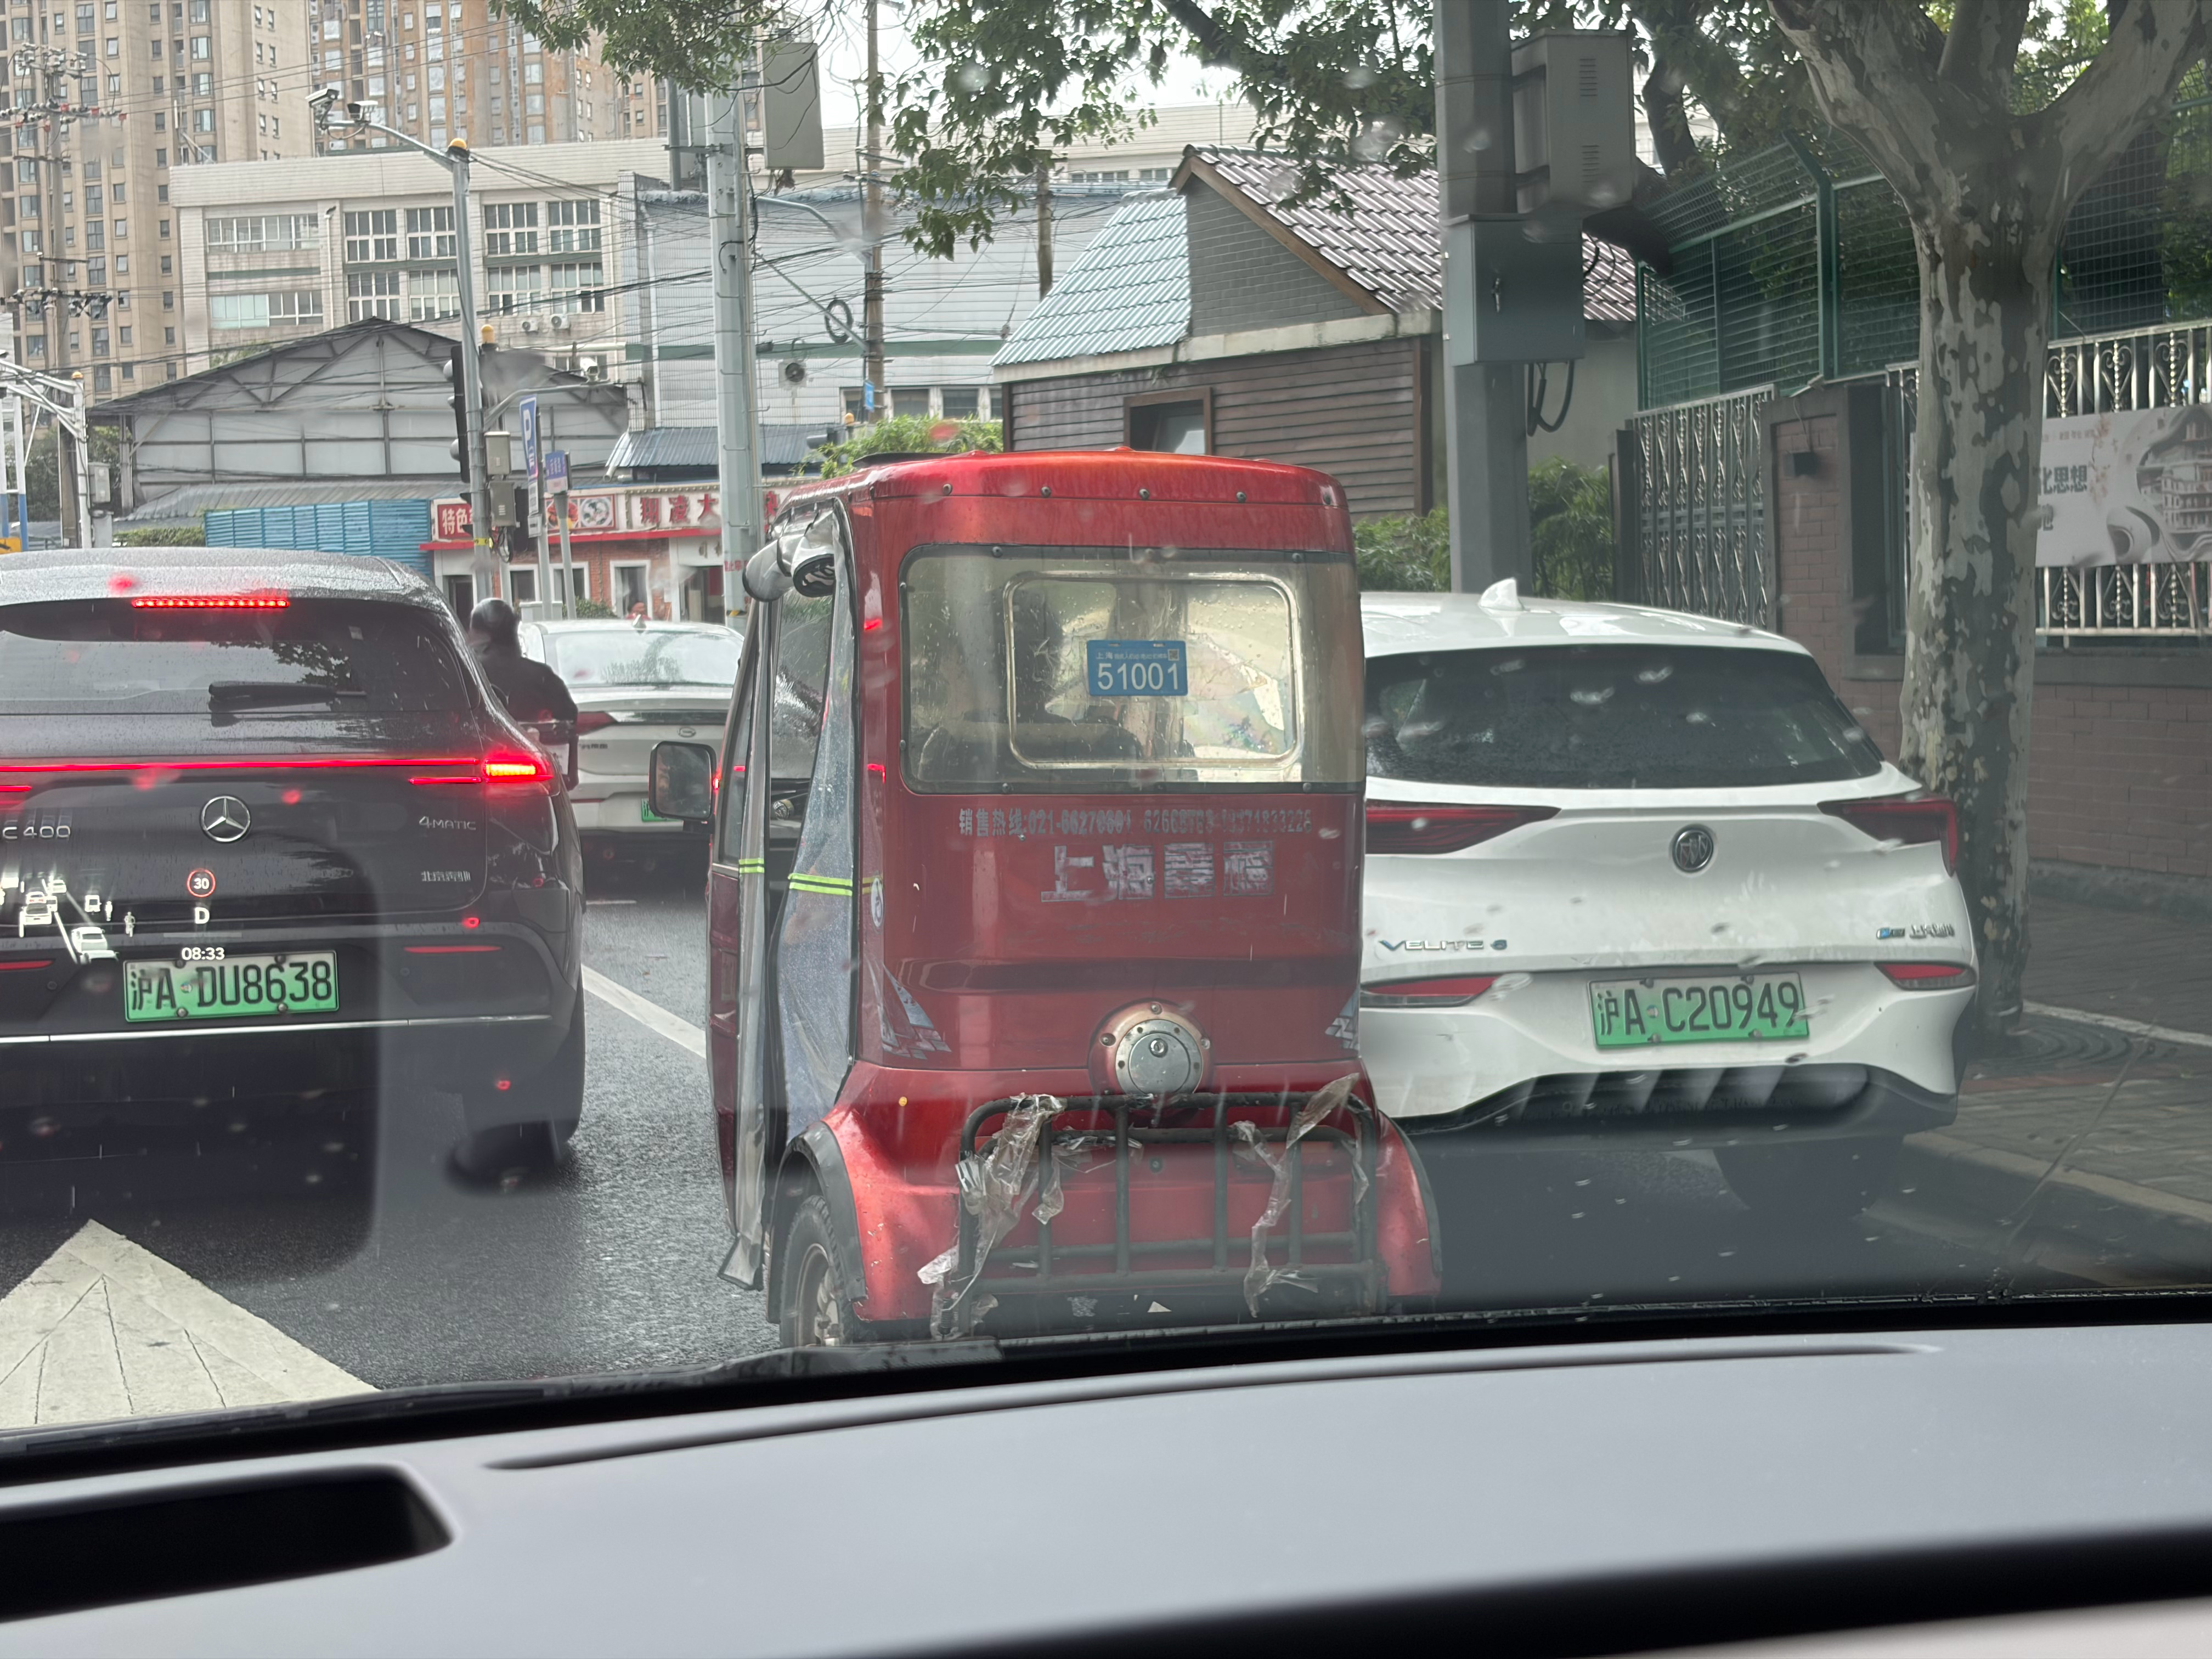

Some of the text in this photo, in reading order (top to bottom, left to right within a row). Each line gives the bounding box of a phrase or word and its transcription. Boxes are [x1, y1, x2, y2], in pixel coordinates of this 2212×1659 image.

[523, 409, 532, 459] P
[442, 508, 473, 535] 特色
[1098, 662, 1178, 690] 51001
[419, 816, 477, 830] 4MATIC
[23, 825, 71, 839] 400
[194, 878, 210, 889] 30
[195, 907, 210, 924] D
[1379, 939, 1508, 951] VELITE 6
[181, 947, 225, 961] 08:33
